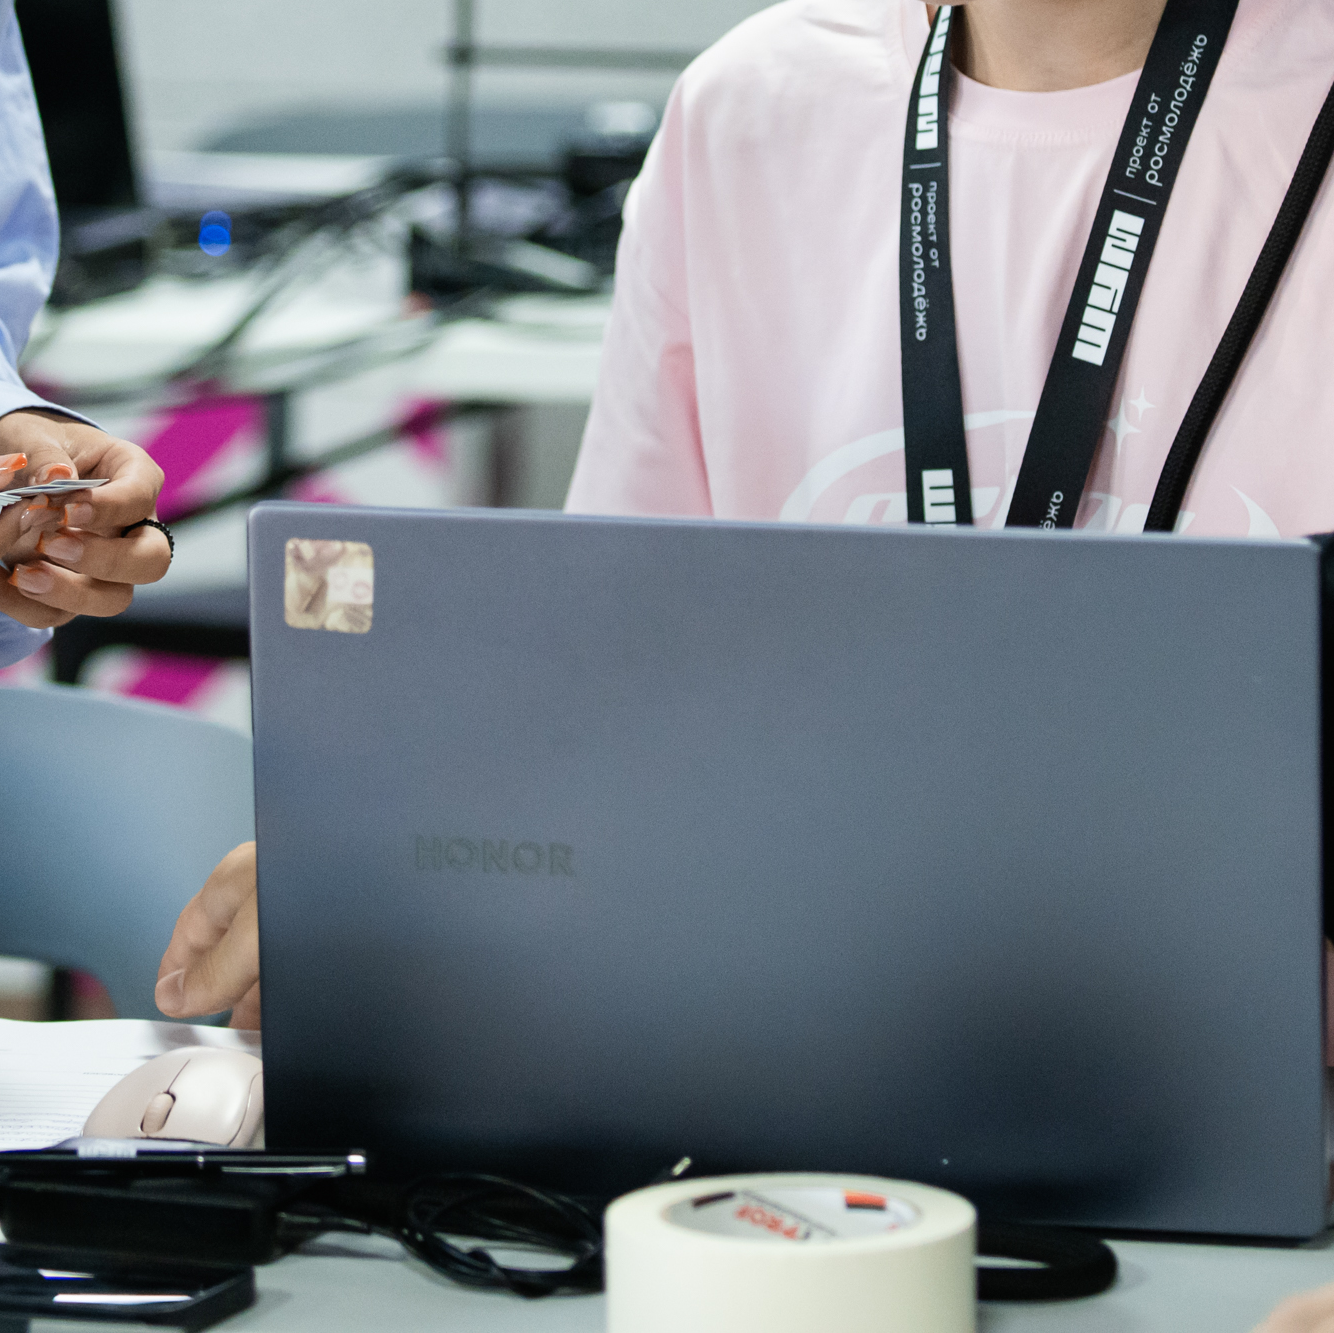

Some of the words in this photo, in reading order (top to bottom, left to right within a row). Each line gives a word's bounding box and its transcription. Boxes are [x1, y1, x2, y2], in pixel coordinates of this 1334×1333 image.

[1125, 117, 1153, 179] проект
[1147, 92, 1162, 114] от
[1145, 33, 1208, 187] росмолодёжь
[926, 181, 938, 243] проект
[908, 182, 930, 342] росмолодёжь
[929, 247, 940, 269] от
[1072, 210, 1145, 367] ШУМ
[414, 834, 576, 877] HONOR
